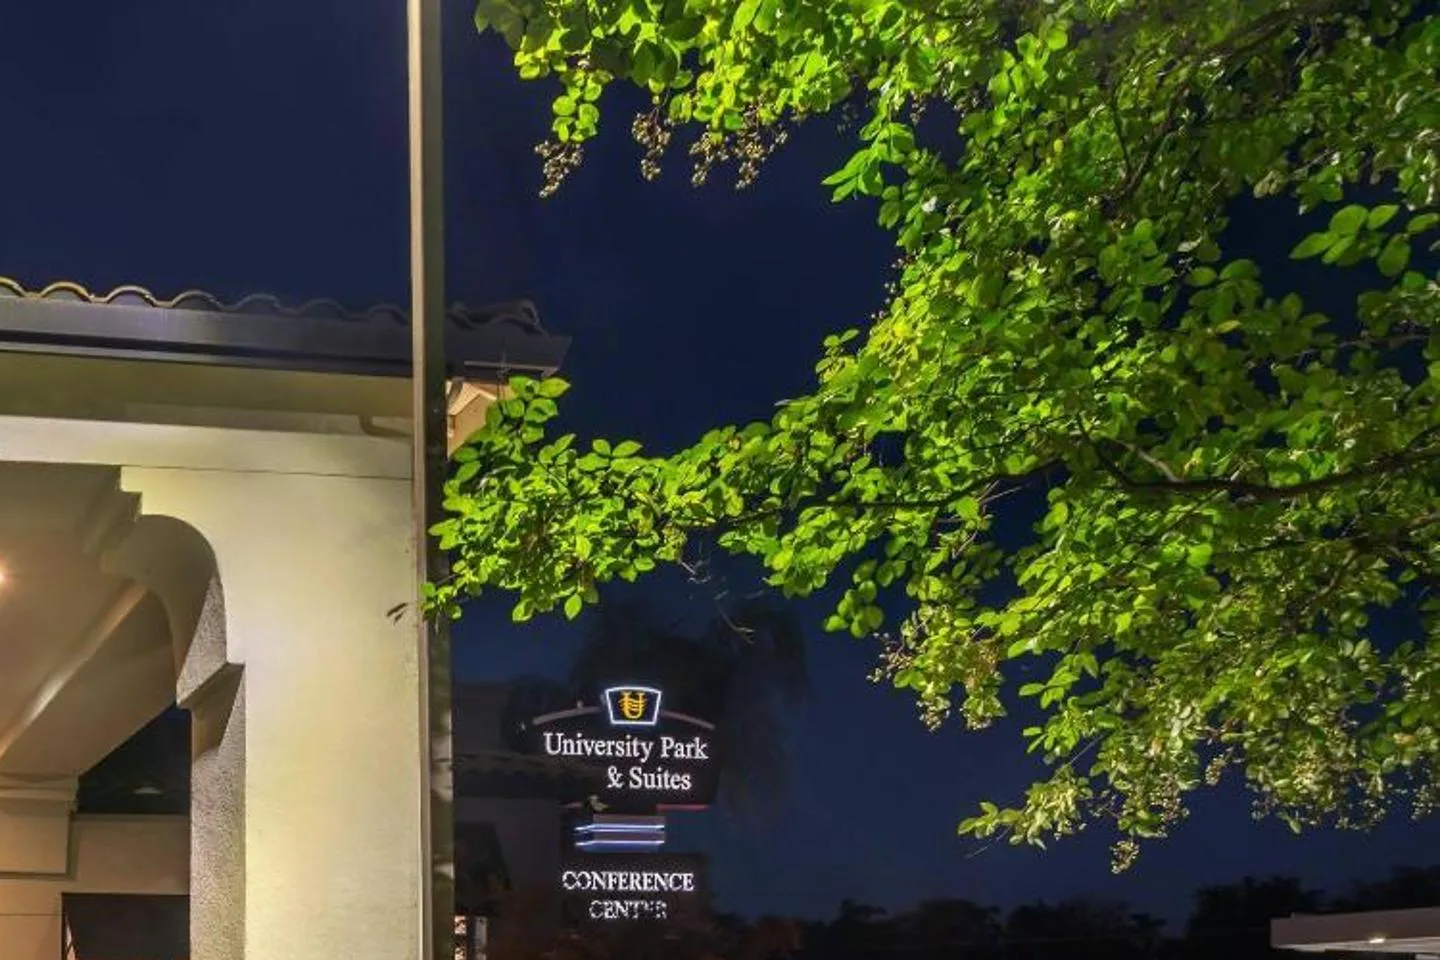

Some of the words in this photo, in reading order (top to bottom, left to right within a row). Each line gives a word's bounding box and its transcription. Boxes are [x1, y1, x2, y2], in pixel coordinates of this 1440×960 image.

[543, 732, 654, 763] University
[660, 736, 709, 760] Park
[607, 765, 625, 789] &
[629, 767, 692, 791] Suites
[562, 870, 695, 892] CONFERENCE
